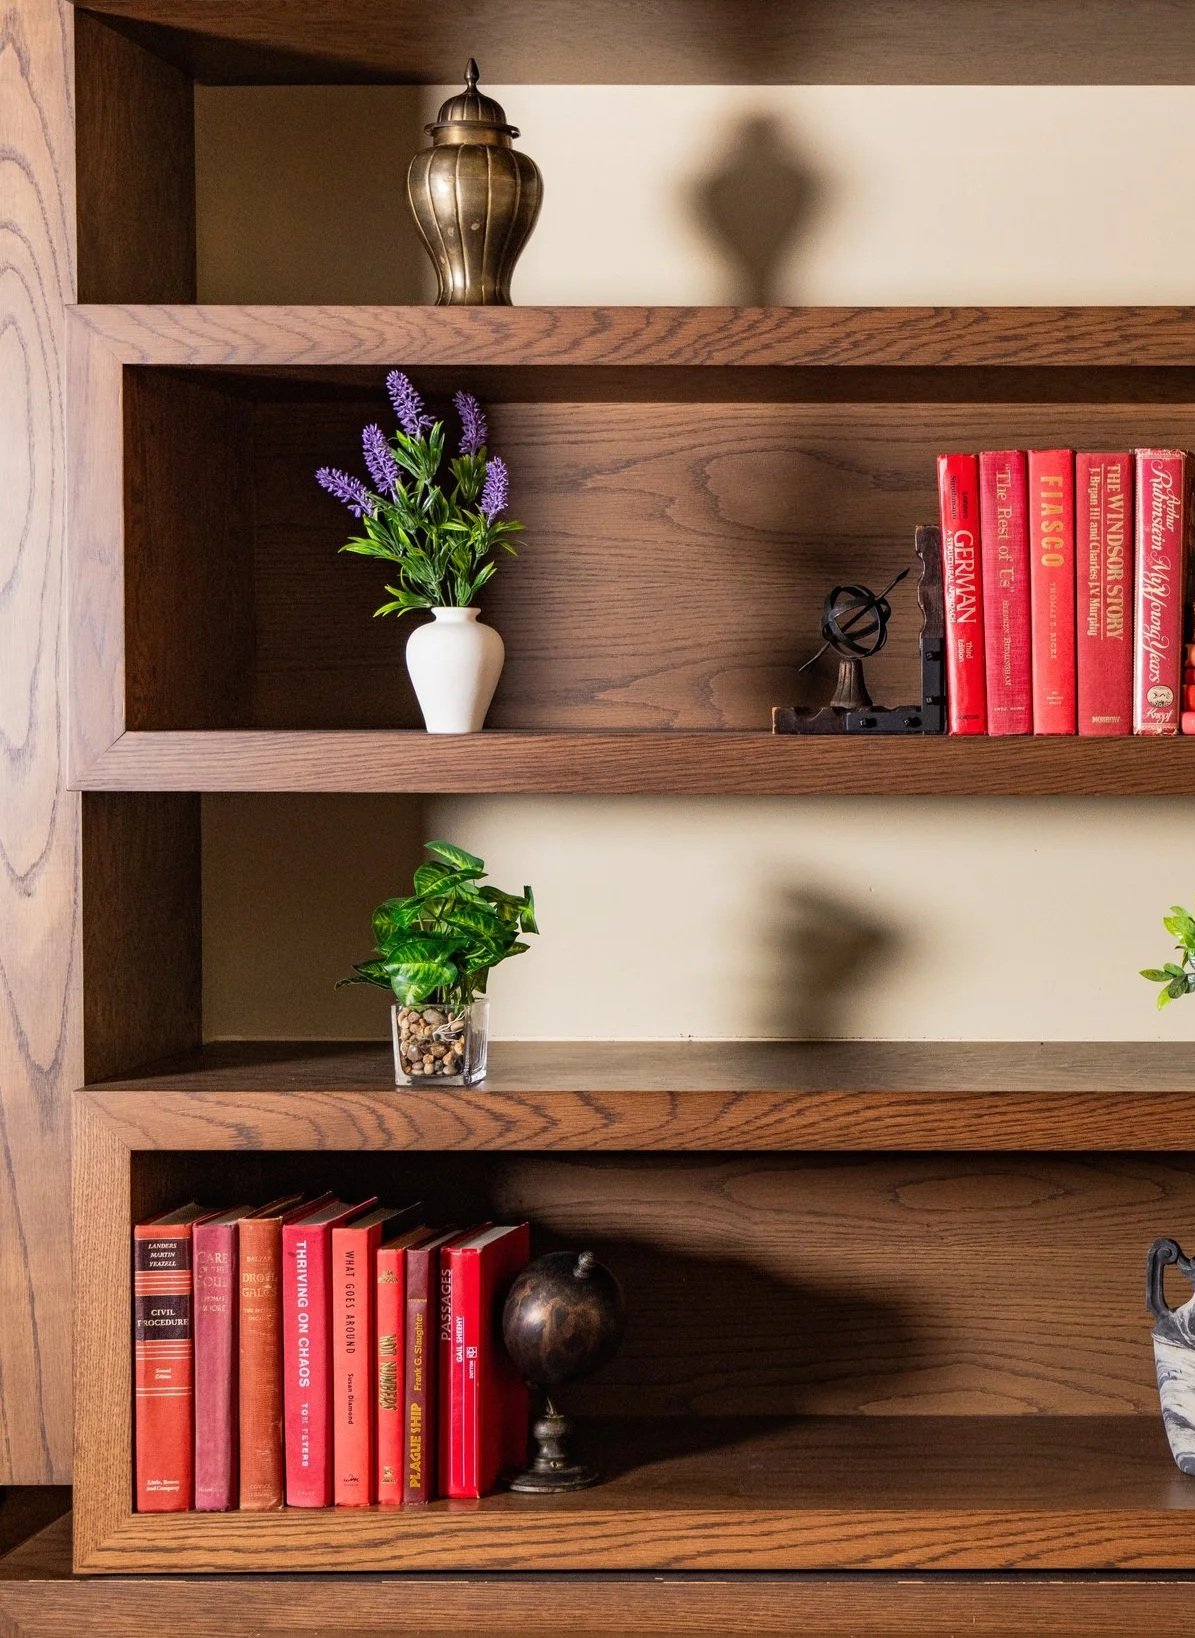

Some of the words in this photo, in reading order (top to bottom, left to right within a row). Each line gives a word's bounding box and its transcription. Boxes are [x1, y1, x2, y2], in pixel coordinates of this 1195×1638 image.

[1088, 476, 1100, 506] Bryan
[1107, 464, 1121, 492] THE
[997, 505, 1012, 540] Rest
[1040, 475, 1064, 567] FIASCO
[1090, 508, 1100, 520] III
[1149, 460, 1173, 550] Rubinstein
[1167, 489, 1181, 532] Arthur
[1090, 522, 1100, 541] and
[1107, 494, 1124, 580] WINDSOR
[946, 537, 954, 583] STRUCTURAL
[998, 545, 1014, 562] of
[1090, 542, 1100, 580] Charles
[1144, 552, 1172, 588] My
[954, 530, 977, 623] GERMAN
[1087, 598, 1100, 635] Murphy
[1107, 584, 1124, 640] STORY
[1143, 584, 1170, 640] Young
[957, 639, 966, 662] Edition
[965, 641, 973, 659] Third
[1143, 635, 1170, 682] Years
[197, 1251, 229, 1264] CARE
[296, 1240, 308, 1307] THRIVING
[345, 1251, 355, 1277] WHAT
[345, 1283, 355, 1308] GOES
[441, 1269, 452, 1341] PASSAGES
[298, 1313, 309, 1333] ON
[345, 1314, 355, 1354] AROUND
[413, 1313, 424, 1354] Slaughter
[299, 1337, 310, 1388] CHAOS
[379, 1333, 398, 1356] HOT
[414, 1356, 423, 1365] G.
[413, 1367, 422, 1391] Frank
[409, 1402, 421, 1433] SHIP
[409, 1435, 421, 1488] PLAGUE
